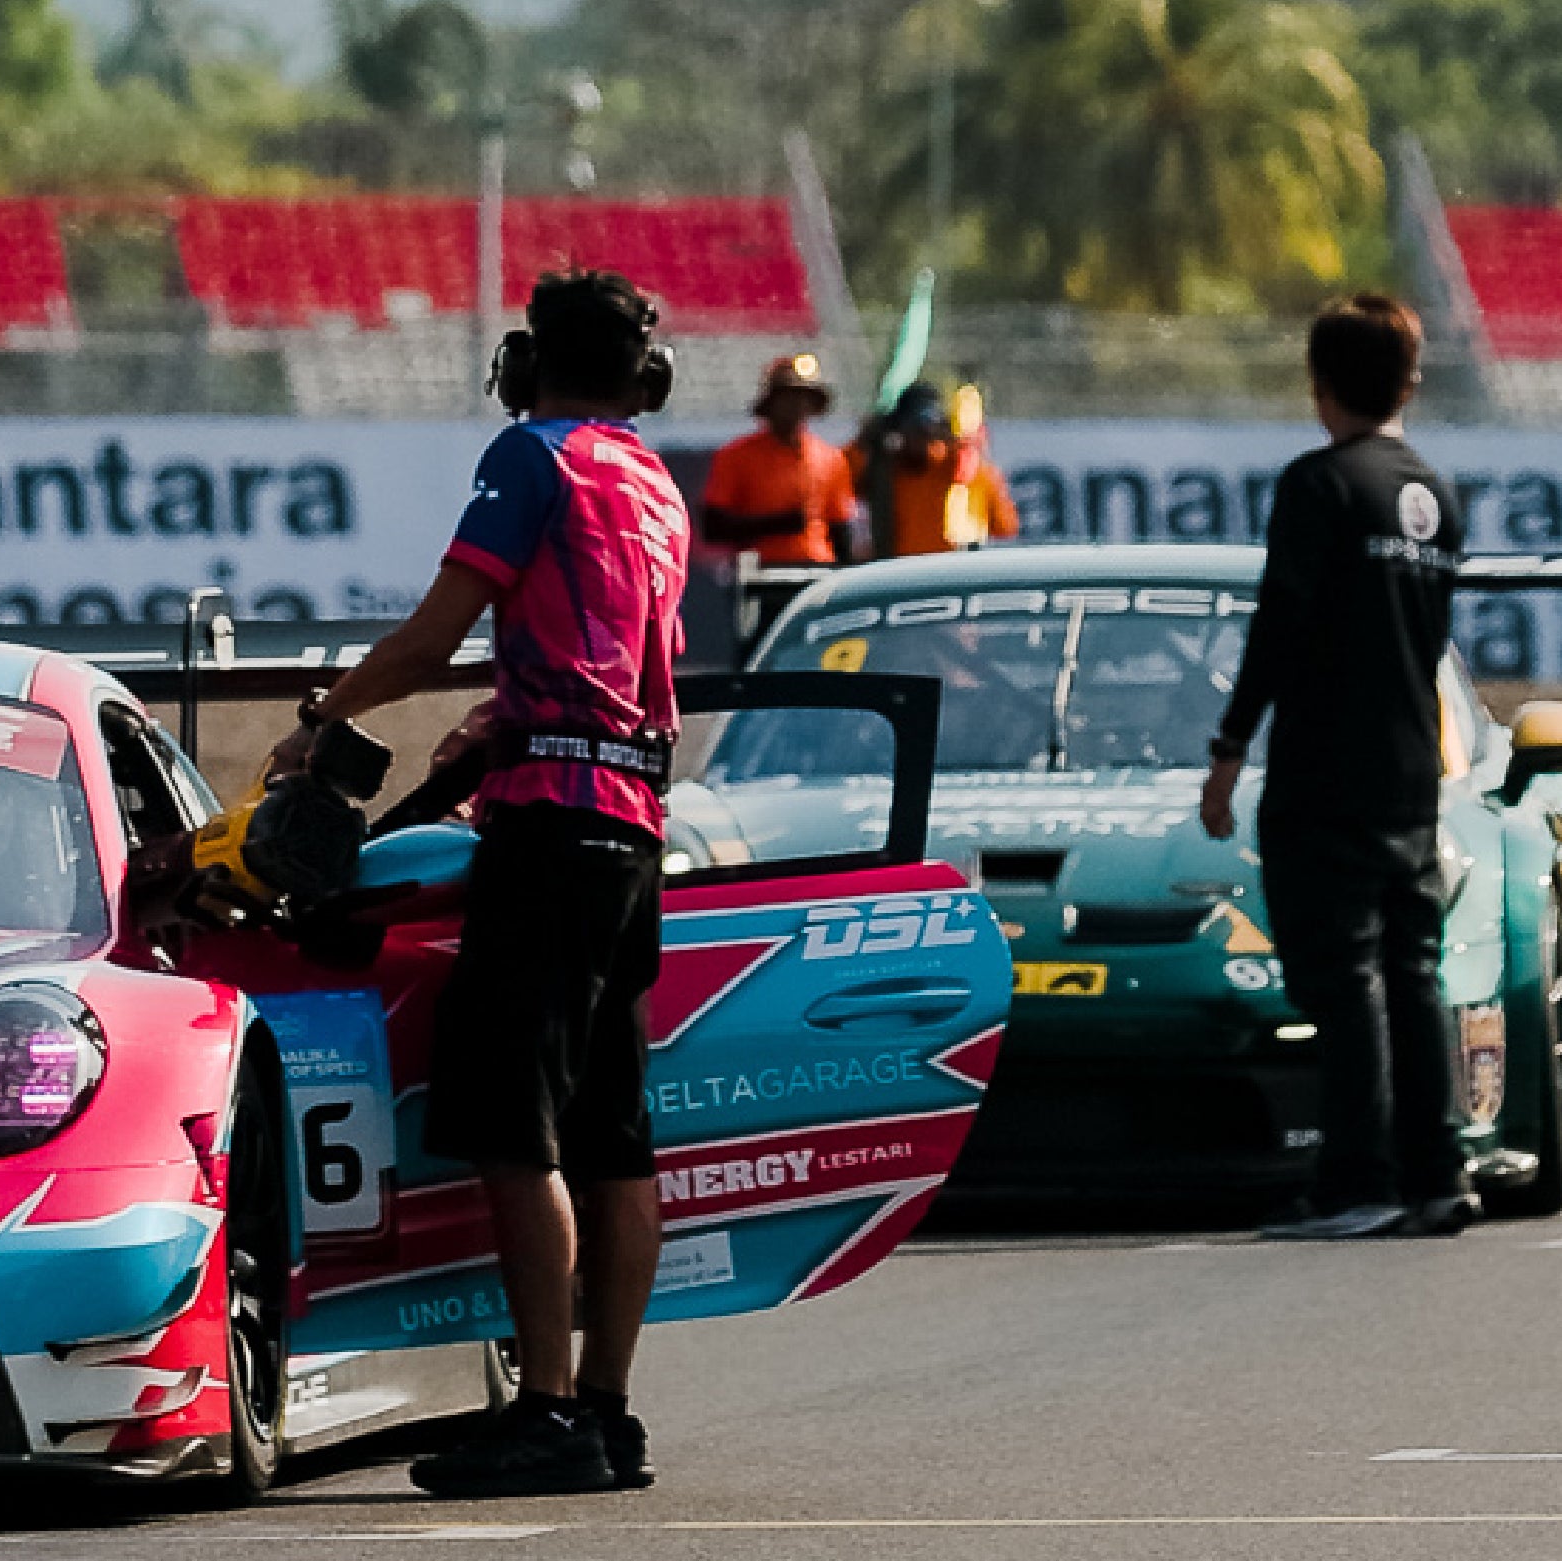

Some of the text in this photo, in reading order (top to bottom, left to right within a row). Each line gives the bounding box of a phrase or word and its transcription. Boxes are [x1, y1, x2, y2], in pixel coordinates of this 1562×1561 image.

[806, 589, 1259, 642] PORSCH
[304, 1101, 363, 1206] 6
[658, 1142, 913, 1203] NERGY LESTARI
[398, 1296, 465, 1332] UNO
